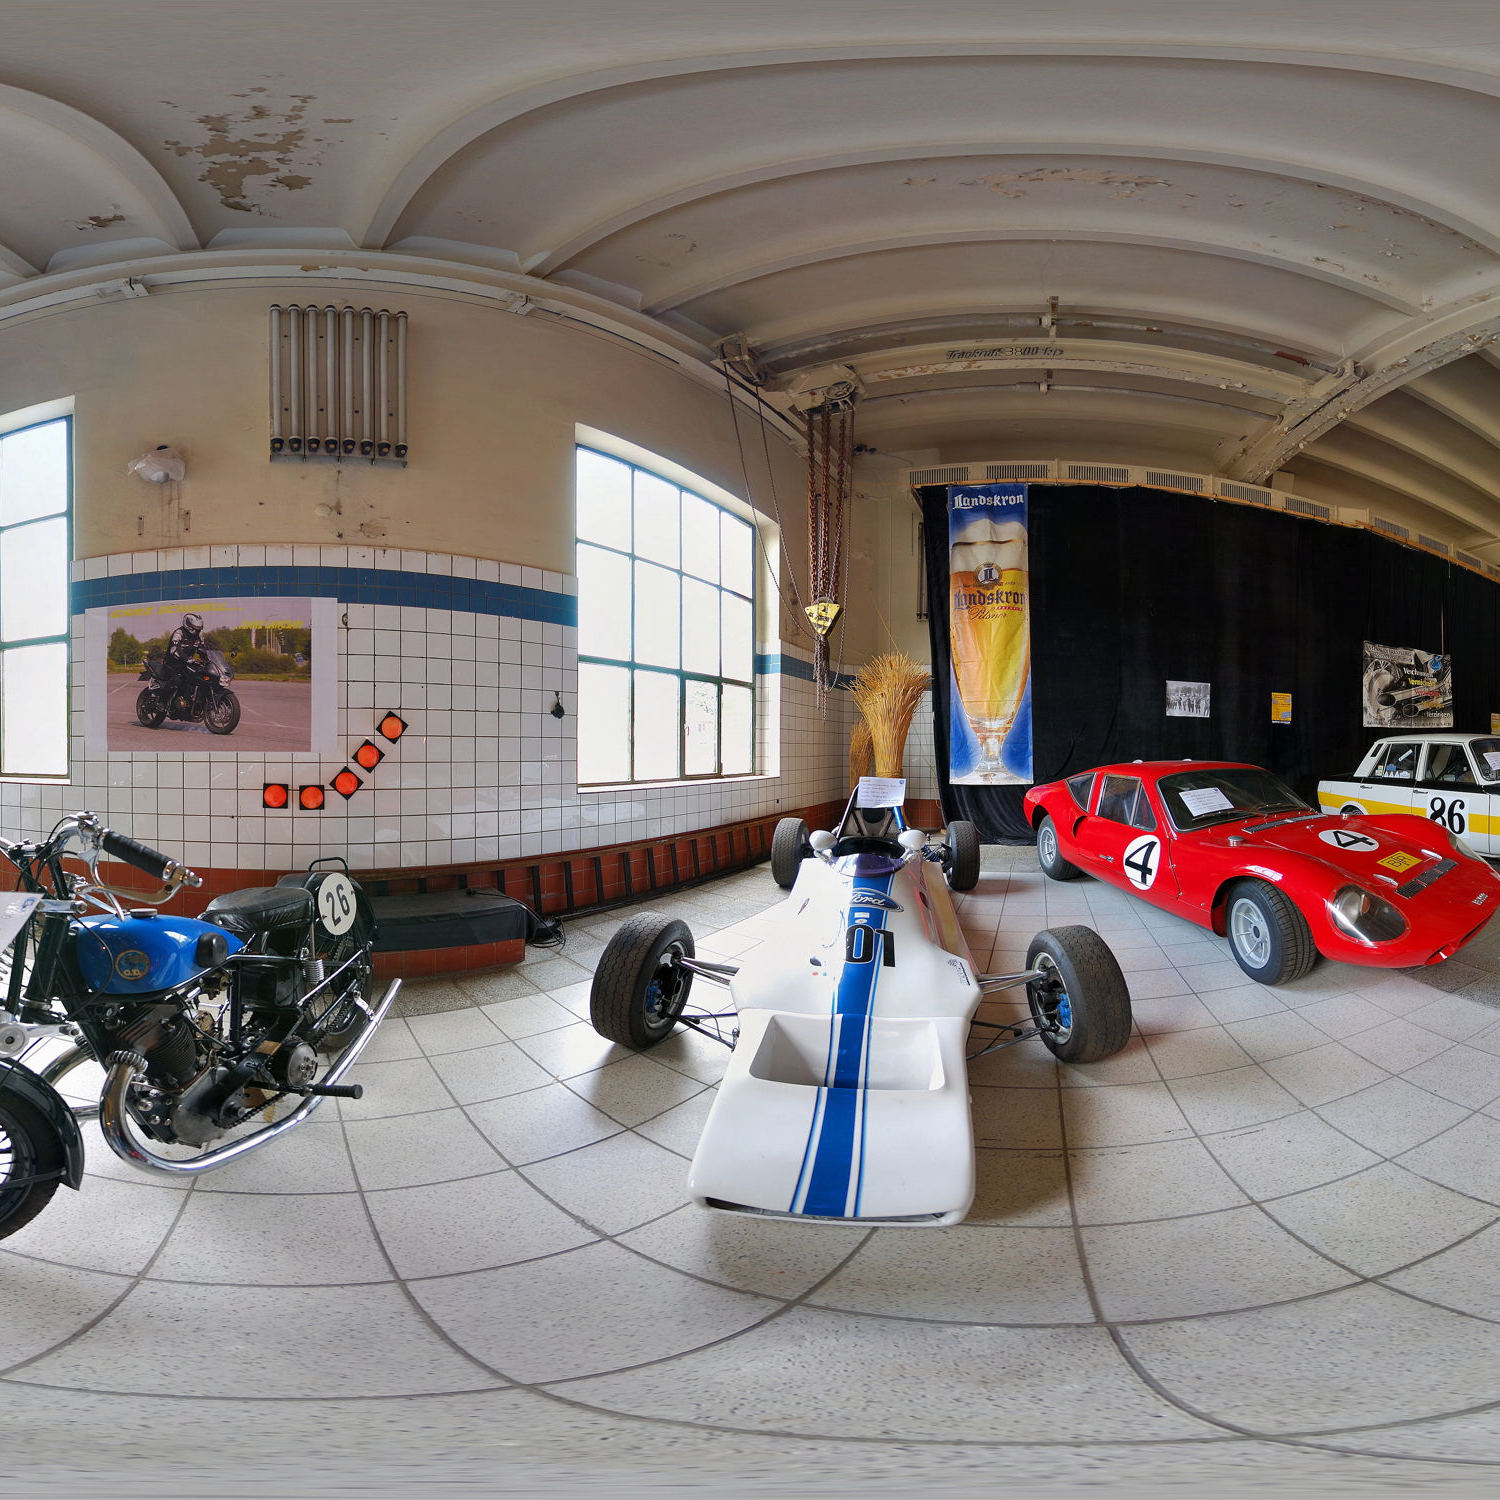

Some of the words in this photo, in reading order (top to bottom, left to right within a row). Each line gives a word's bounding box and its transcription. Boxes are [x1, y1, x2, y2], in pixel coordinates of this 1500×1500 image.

[953, 494, 1024, 510] Landskron
[954, 589, 1026, 610] Landskron
[968, 605, 1008, 621] Pilsner
[1429, 796, 1465, 835] 86
[1332, 830, 1375, 848] 4
[1124, 841, 1158, 885] 4
[325, 883, 350, 927] 26
[852, 892, 886, 906] Ford
[845, 924, 896, 967] 01
